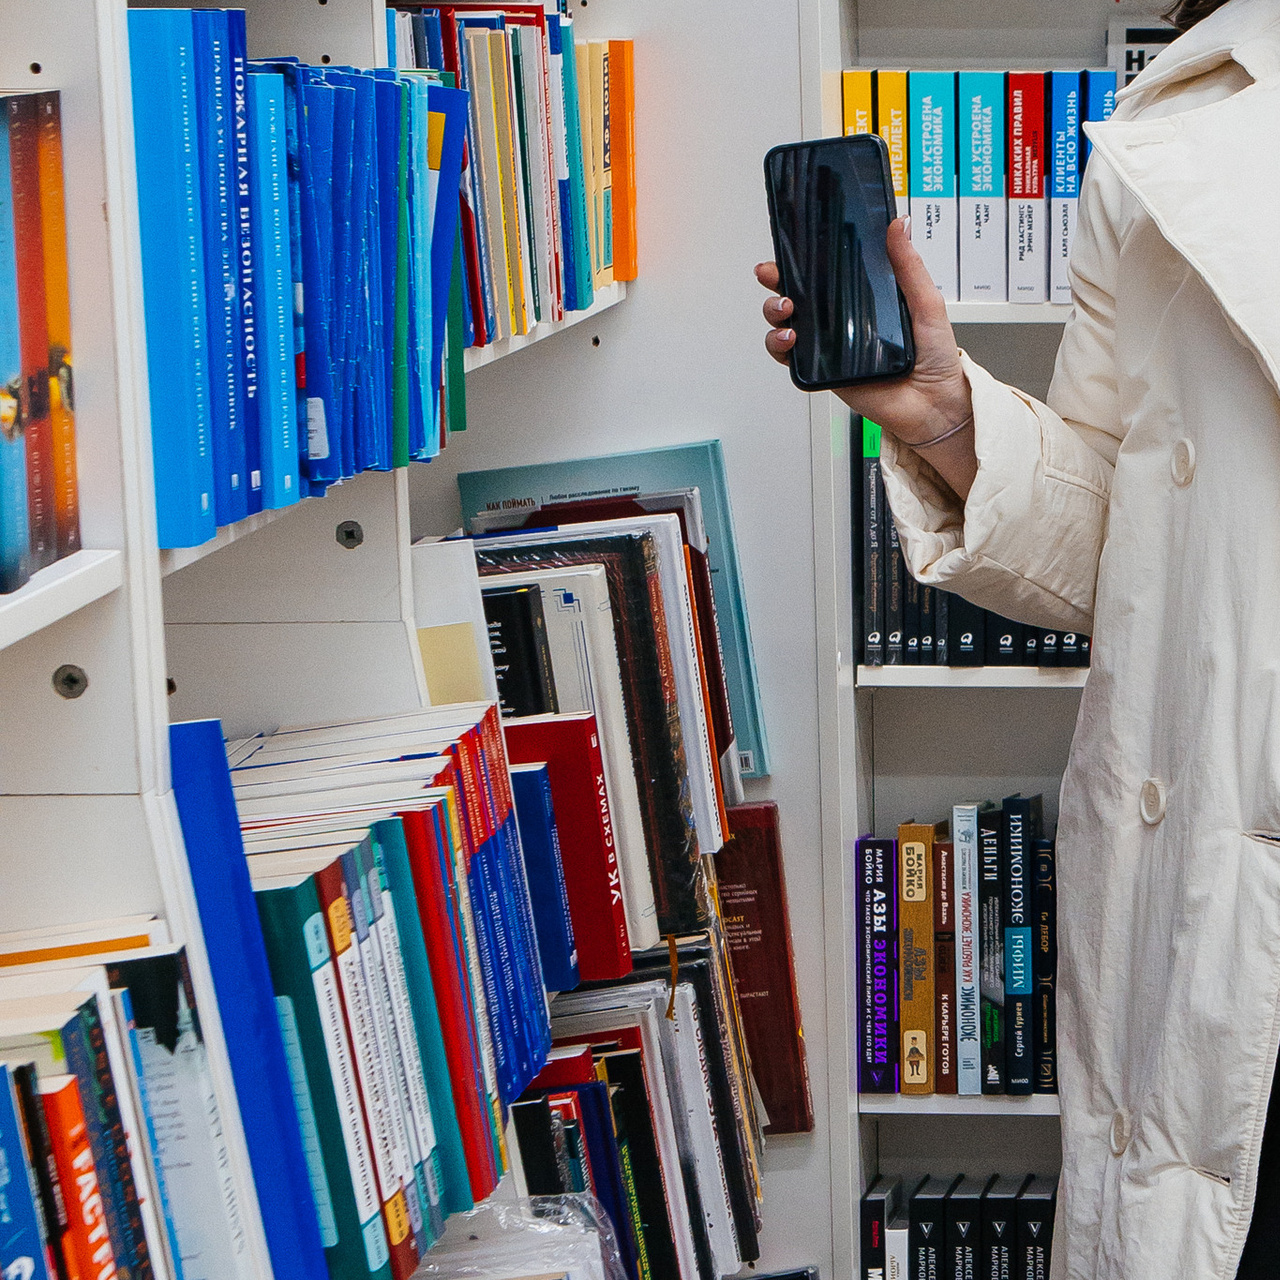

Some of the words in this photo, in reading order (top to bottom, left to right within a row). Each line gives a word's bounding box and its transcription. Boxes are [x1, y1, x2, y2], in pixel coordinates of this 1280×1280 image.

[233, 57, 250, 199] ПОЖАРНАЯ
[922, 96, 932, 162] УСТРОЕНА
[972, 96, 981, 162] УСТРОЕНА
[1013, 90, 1022, 134] ПРАВИЛ
[1066, 91, 1076, 140] ЖИЗНЬ
[933, 107, 943, 191] ЭКОНОМИКА
[982, 107, 992, 191] ЭКОНОМИКА
[1014, 137, 1022, 194] НИКАКИХ
[1055, 132, 1065, 193] КЛИЕНТЫ
[1067, 143, 1076, 171] ВСЮ
[923, 165, 932, 191] КАК
[972, 165, 981, 191] КАК
[1067, 175, 1076, 193] НА
[237, 207, 257, 399] БЕЗОПАСНОСТЬ
[596, 773, 613, 847] СХЕМАХ
[608, 852, 616, 864] В
[865, 849, 874, 884] БОЙКО
[905, 846, 917, 898] БОЙКО
[980, 829, 998, 880] ДЕНЬГИ
[1010, 814, 1023, 924] ЭКОНОМИКИ
[608, 867, 622, 905] УК
[874, 889, 886, 932] АЗЫ
[1012, 934, 1024, 989] МИФЫ
[874, 940, 887, 1064] ЭКОНОМИКИ
